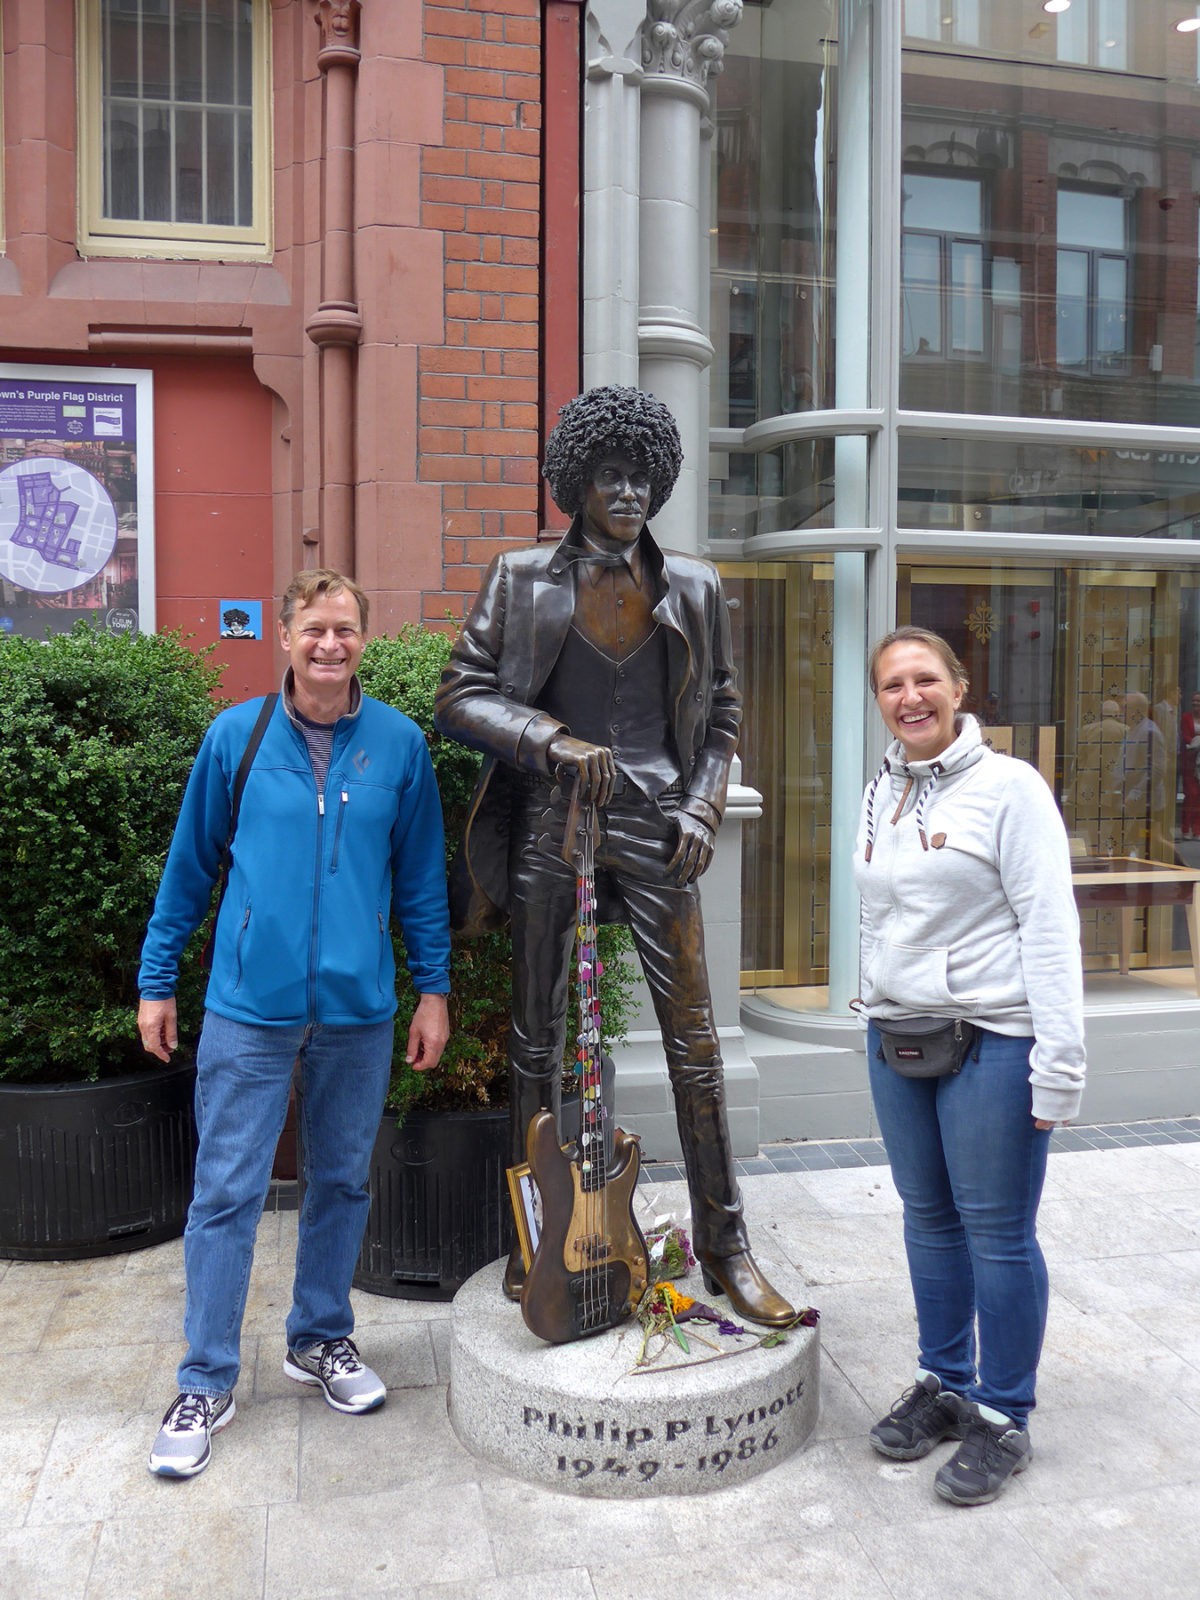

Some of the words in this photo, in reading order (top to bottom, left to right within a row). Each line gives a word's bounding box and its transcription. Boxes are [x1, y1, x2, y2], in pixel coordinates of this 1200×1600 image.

[0, 390, 24, 400] wn's
[27, 391, 61, 403] Purple
[63, 392, 85, 403] Flag
[87, 392, 124, 402] District
[523, 1406, 655, 1452] Philip
[666, 1419, 692, 1442] P
[706, 1379, 806, 1440] Lynott
[556, 1455, 661, 1482] 1949
[697, 1426, 780, 1474] 1986
